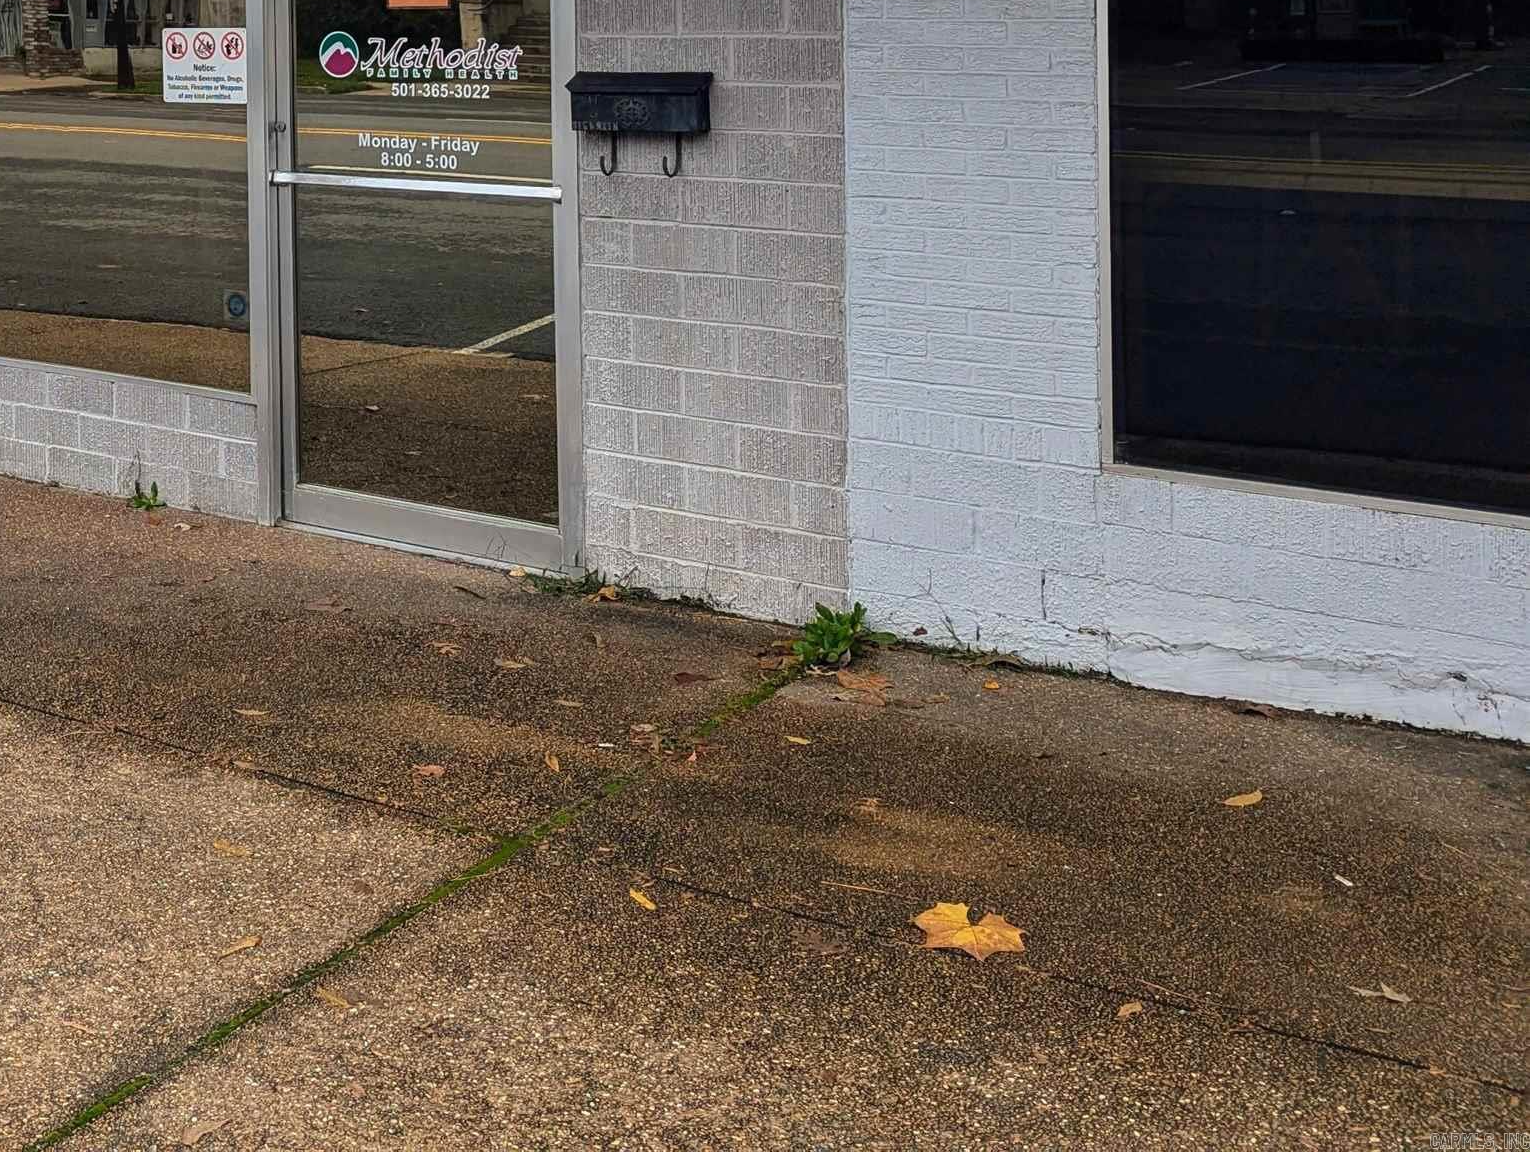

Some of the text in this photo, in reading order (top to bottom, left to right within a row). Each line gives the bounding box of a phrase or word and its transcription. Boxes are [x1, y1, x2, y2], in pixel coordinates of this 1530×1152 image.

[360, 36, 523, 71] Methodist
[193, 63, 217, 72] Notice:
[366, 67, 519, 80] FAMILY HEALTH
[391, 82, 490, 99] 501-365-3022
[358, 133, 417, 153] Monday
[431, 137, 480, 156] Friday
[381, 152, 412, 168] 8:00
[425, 154, 458, 170] 5:00
